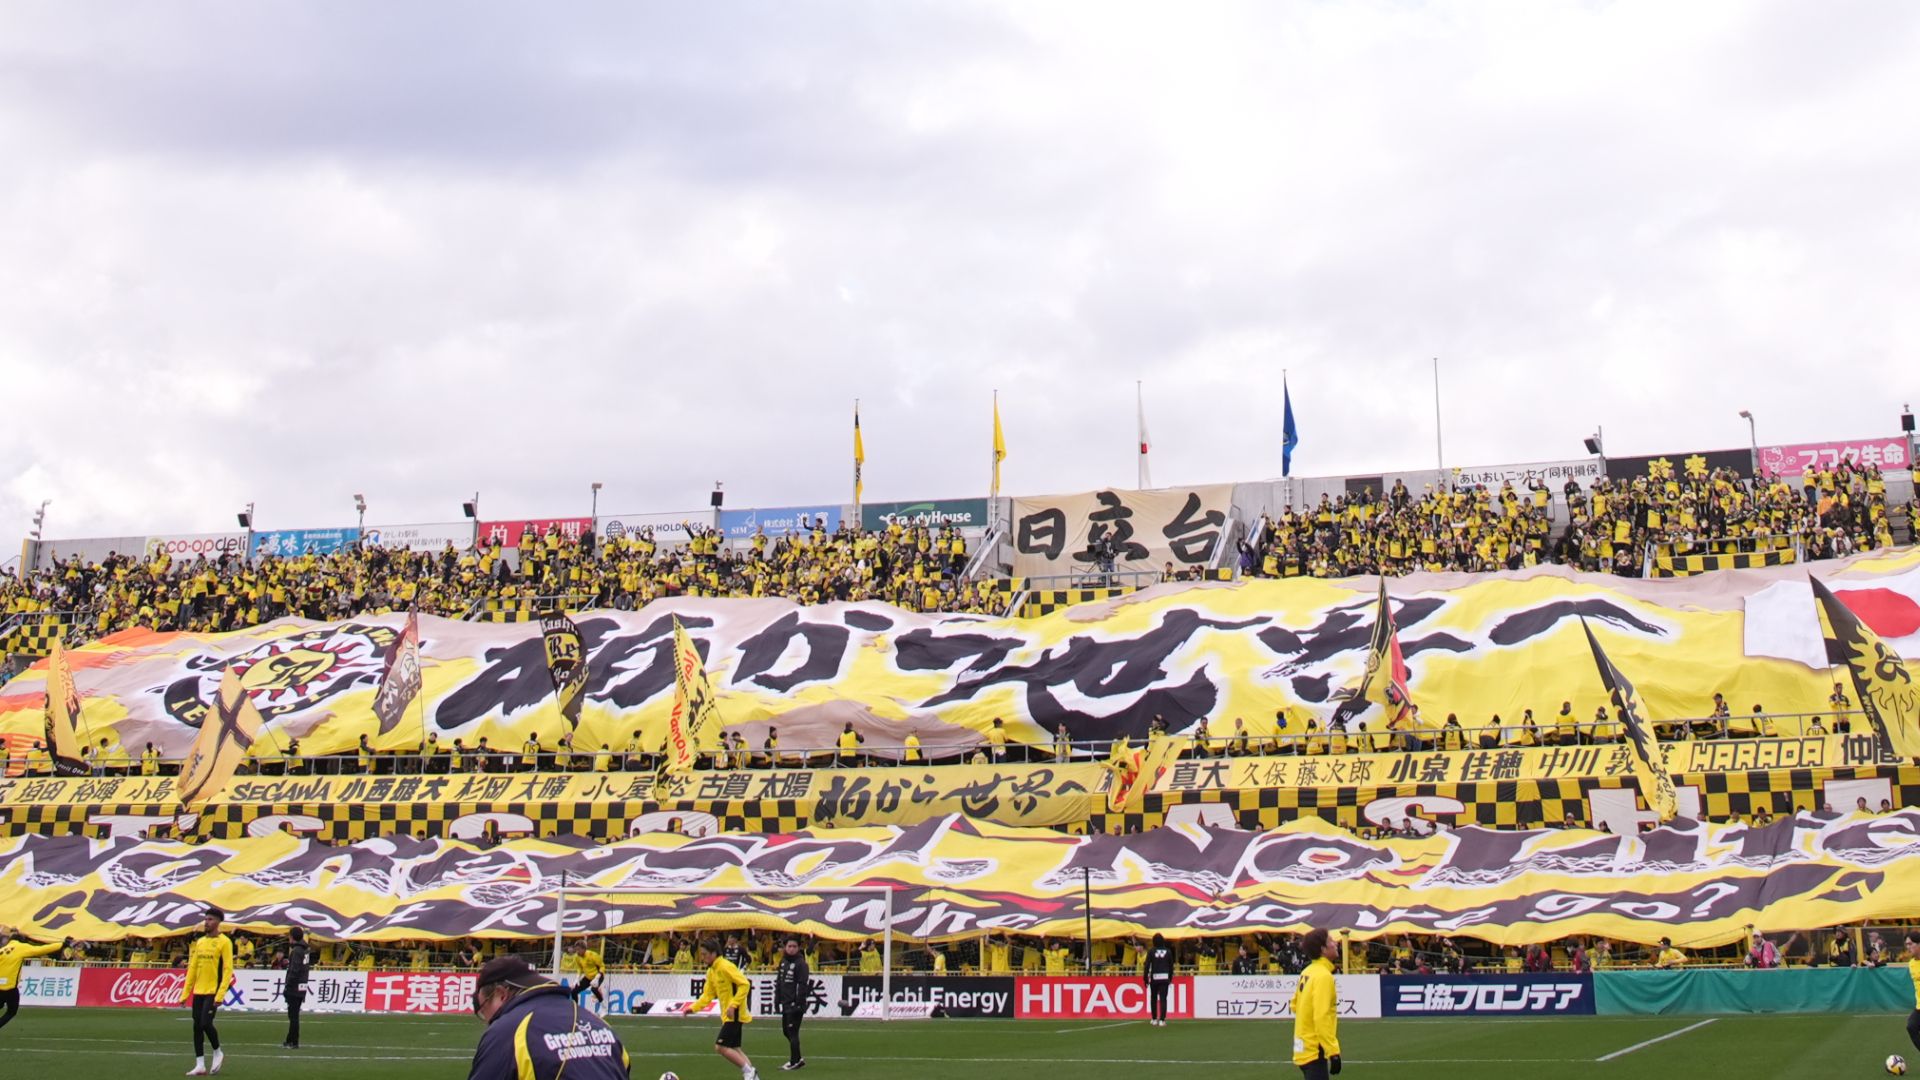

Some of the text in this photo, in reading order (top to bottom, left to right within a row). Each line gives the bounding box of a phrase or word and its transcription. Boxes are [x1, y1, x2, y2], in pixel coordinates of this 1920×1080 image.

[1797, 443, 1905, 469] フコク生命
[1459, 463, 1599, 487] あいおいニッセイ同和損保
[1016, 490, 1225, 563] 日立台
[1387, 753, 1451, 783] 小泉
[1538, 747, 1602, 778] 中川
[1688, 736, 1825, 773] HARADA
[696, 770, 814, 799] 古賀 太陽
[1239, 756, 1374, 787] 久保 藤次郎
[229, 778, 330, 801] SEGAWA
[814, 768, 1089, 821] 柏から世界へ
[930, 986, 1008, 1014] Energy
[1396, 983, 1583, 1011] 三協フロンテア
